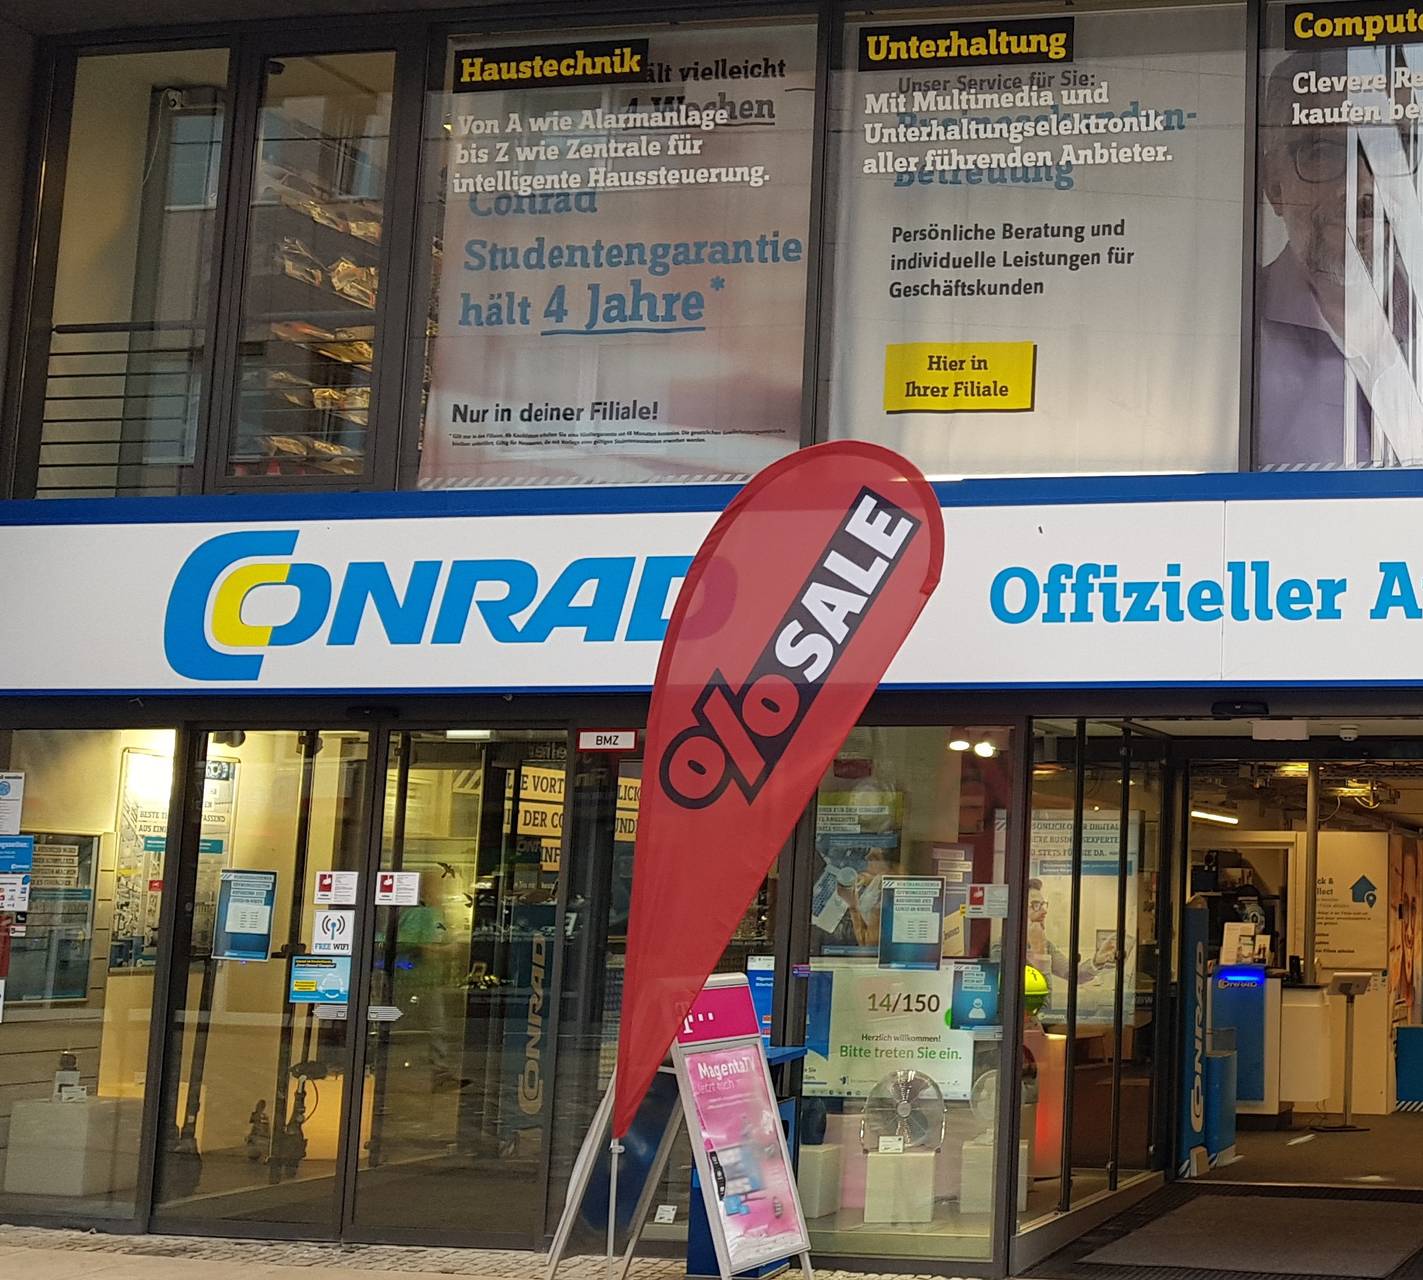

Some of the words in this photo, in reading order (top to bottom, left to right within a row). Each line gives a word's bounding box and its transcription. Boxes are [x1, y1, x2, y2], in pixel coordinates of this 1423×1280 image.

[867, 30, 1066, 61] Unterhaltung
[460, 47, 641, 83] Haustechnik
[646, 62, 672, 84] ält
[679, 57, 787, 81] vielleicht
[898, 76, 950, 94] Unser
[957, 73, 1023, 90] Service
[1029, 71, 1055, 89] für
[1060, 70, 1096, 87] Sie:
[1292, 69, 1387, 94] Clevere
[864, 93, 906, 114] Mit
[912, 85, 1054, 112] Multimedia
[1061, 82, 1109, 106] und
[457, 115, 499, 135] Von
[505, 113, 523, 132] A
[529, 111, 572, 132] wie
[579, 105, 728, 130] Alarmanlage
[864, 109, 1164, 144] Unterhaltungselektronik
[1291, 102, 1381, 127] kaufen
[455, 144, 488, 165] bis
[495, 142, 509, 163] Z
[516, 138, 559, 161] wie
[566, 135, 661, 160] Zentrale
[667, 134, 703, 155] für
[862, 151, 919, 174] aller
[925, 146, 1052, 172] führenden
[1059, 143, 1173, 167] Anbieter.
[452, 170, 581, 196] intelligente
[587, 165, 770, 188] Haussteuerung.
[891, 224, 996, 244] Persönliche
[1002, 222, 1085, 243] Beratung
[1091, 219, 1125, 238] und
[463, 231, 802, 276] Studentengarantie
[890, 251, 996, 271] individuelle
[1002, 248, 1101, 271] Leistungen
[1107, 246, 1134, 265] für
[889, 279, 1044, 298] Geschäftskunden
[458, 291, 531, 327] hält
[543, 285, 568, 323] 4
[927, 355, 966, 372] Hier
[970, 355, 988, 372] in
[905, 380, 948, 398] Ihrer
[953, 379, 1009, 397] Filiale
[451, 403, 488, 424] Nur
[495, 402, 512, 422] in
[519, 402, 584, 423] deiner
[590, 400, 659, 422] Filiale!
[775, 494, 915, 684] SALE
[989, 561, 1347, 624] Offizieller
[164, 529, 738, 681] CONRAD
[595, 735, 620, 746] BMZ
[203, 815, 226, 823] ASSEND
[523, 810, 547, 828] DER
[315, 943, 332, 951] FREE
[333, 943, 350, 951] WIFI
[867, 992, 940, 1013] 14/150
[518, 930, 546, 1115] CONRAD
[861, 1033, 892, 1042] Herzlich
[893, 1033, 942, 1043] willkommen!
[840, 1045, 871, 1058] Bitte
[874, 1046, 914, 1059] treten
[917, 1046, 936, 1059] Sie
[939, 1047, 962, 1060] ein.
